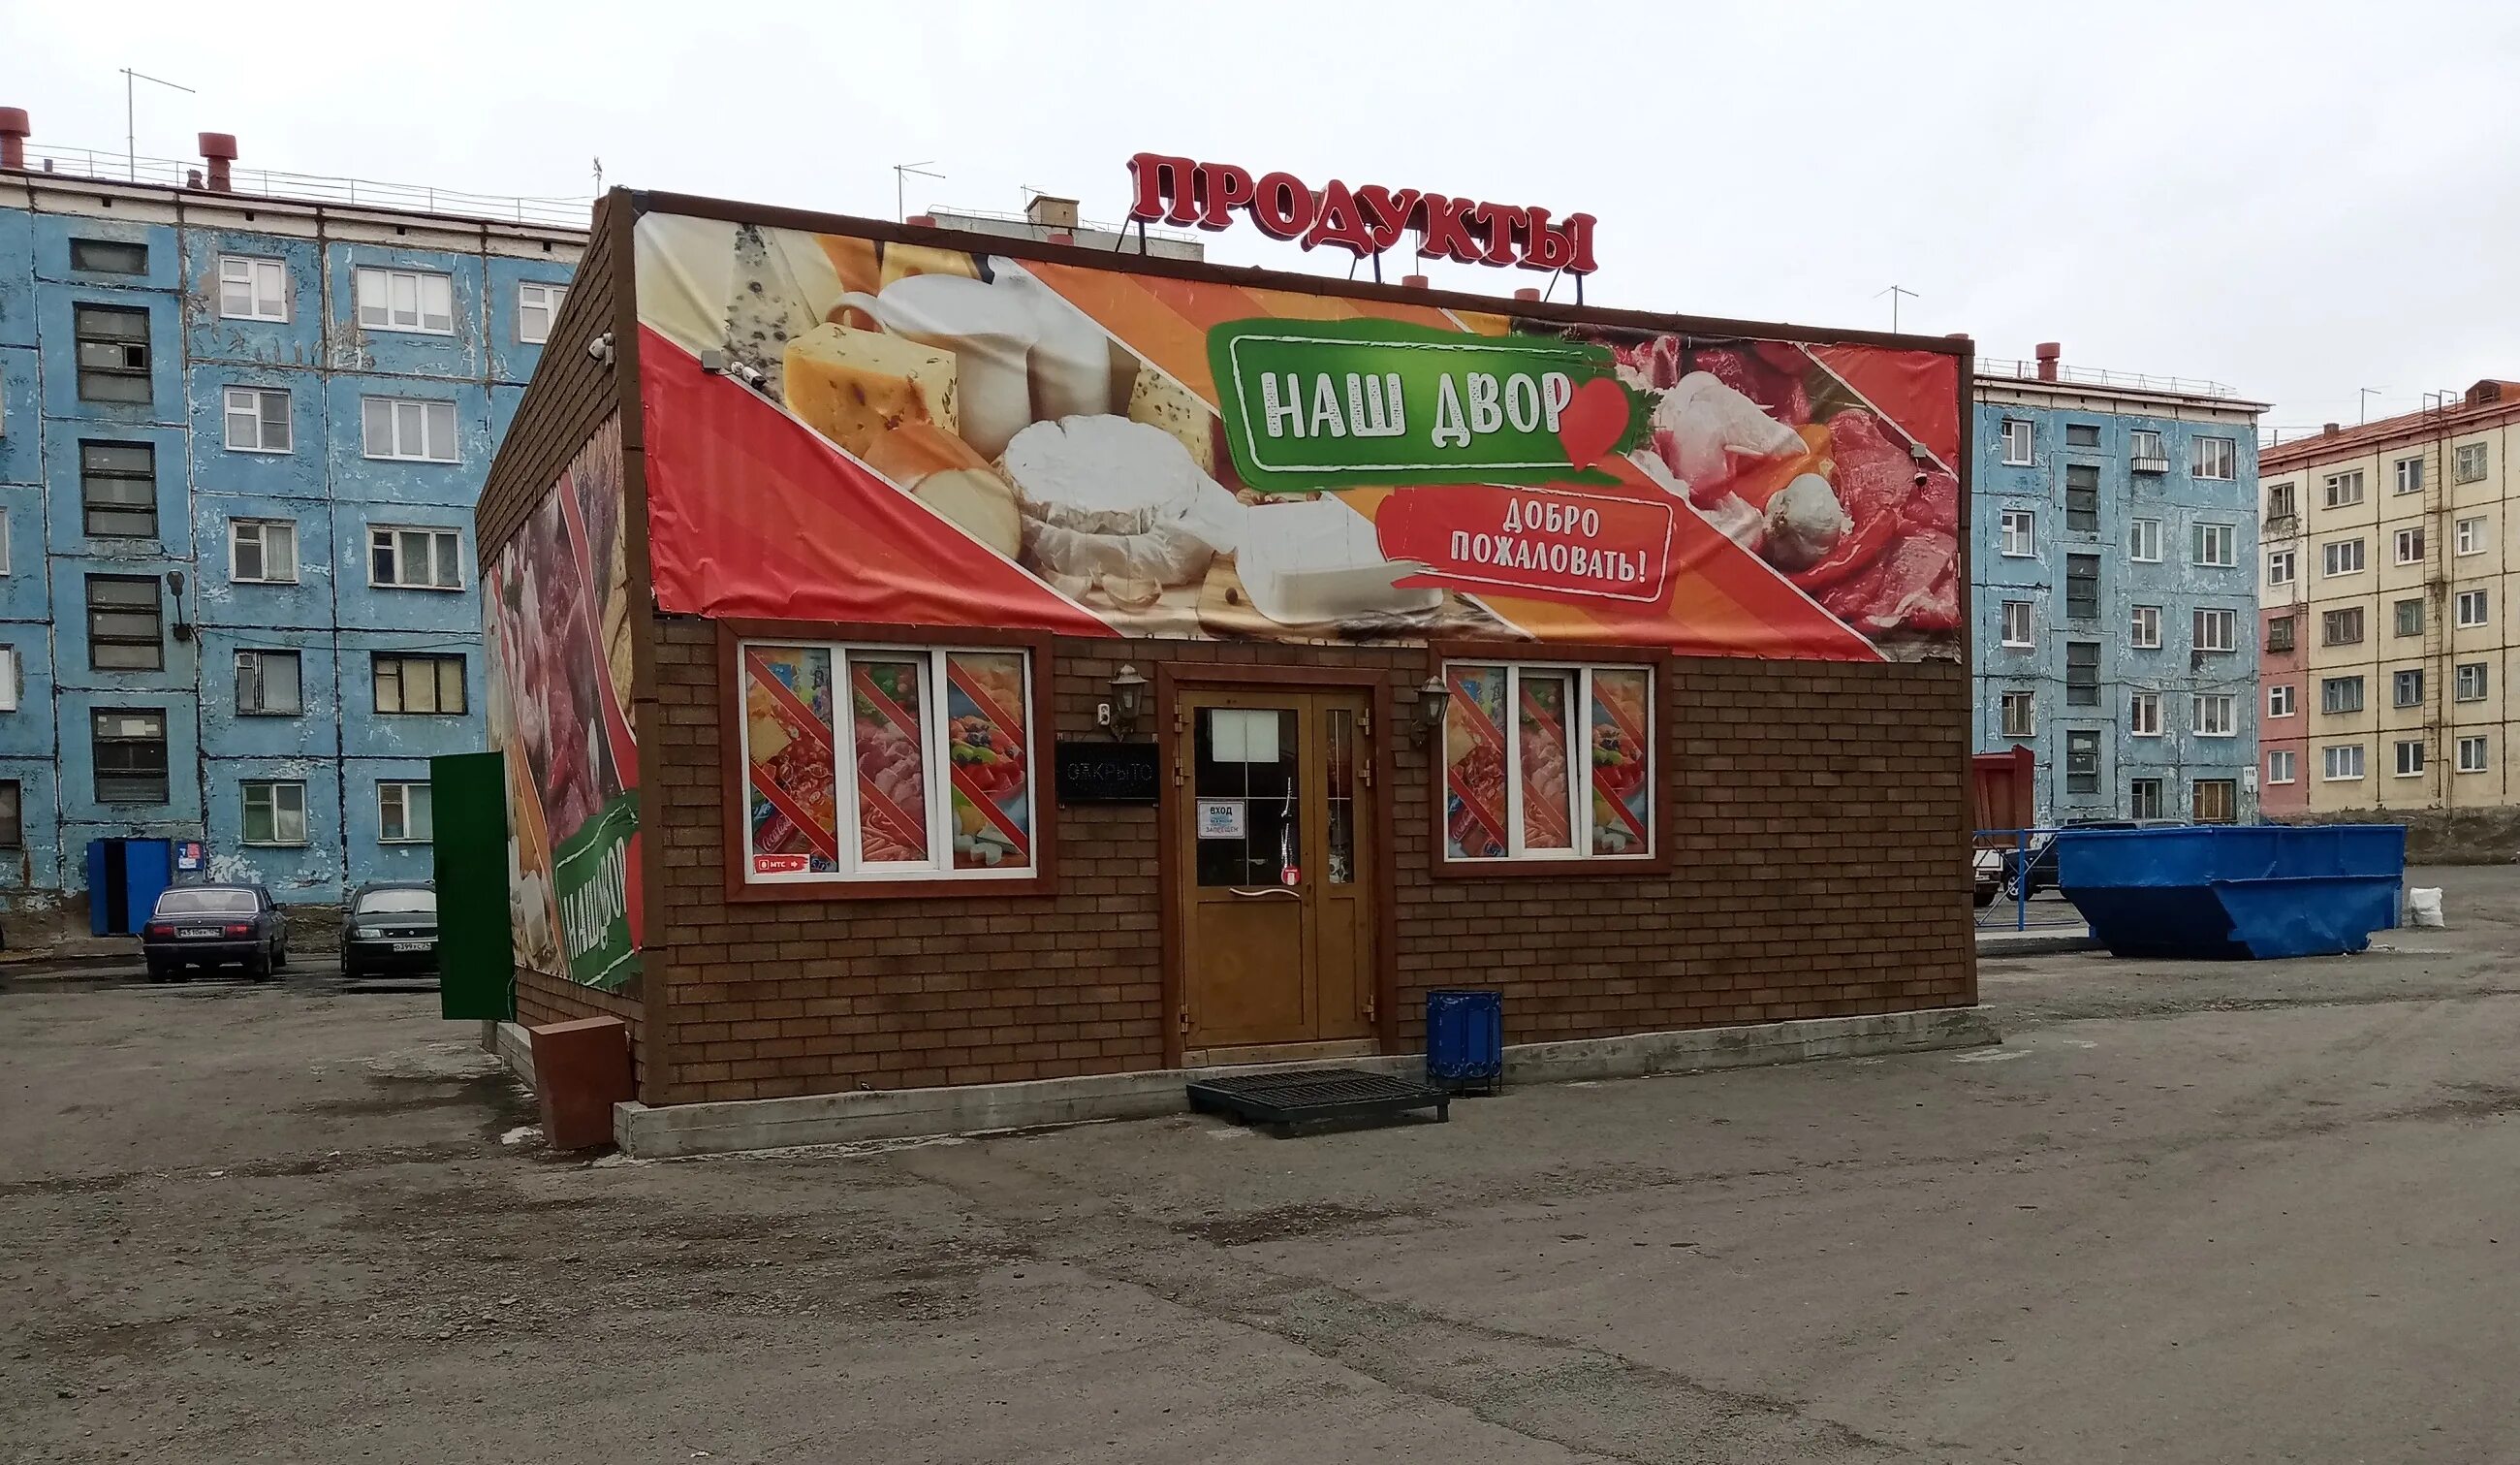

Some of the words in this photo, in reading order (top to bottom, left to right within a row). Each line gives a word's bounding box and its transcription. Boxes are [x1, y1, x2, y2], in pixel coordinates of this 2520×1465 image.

[1127, 153, 1597, 273] ПРОДУКТЫ
[1260, 371, 1407, 439] НАШ
[1431, 371, 1573, 449] ДВОР
[1502, 496, 1600, 538] ДОБРО
[1450, 529, 1648, 584] ПОЖАЛОВАТЬ!
[1210, 806, 1233, 816] ВХОД
[563, 875, 600, 960] НАШ
